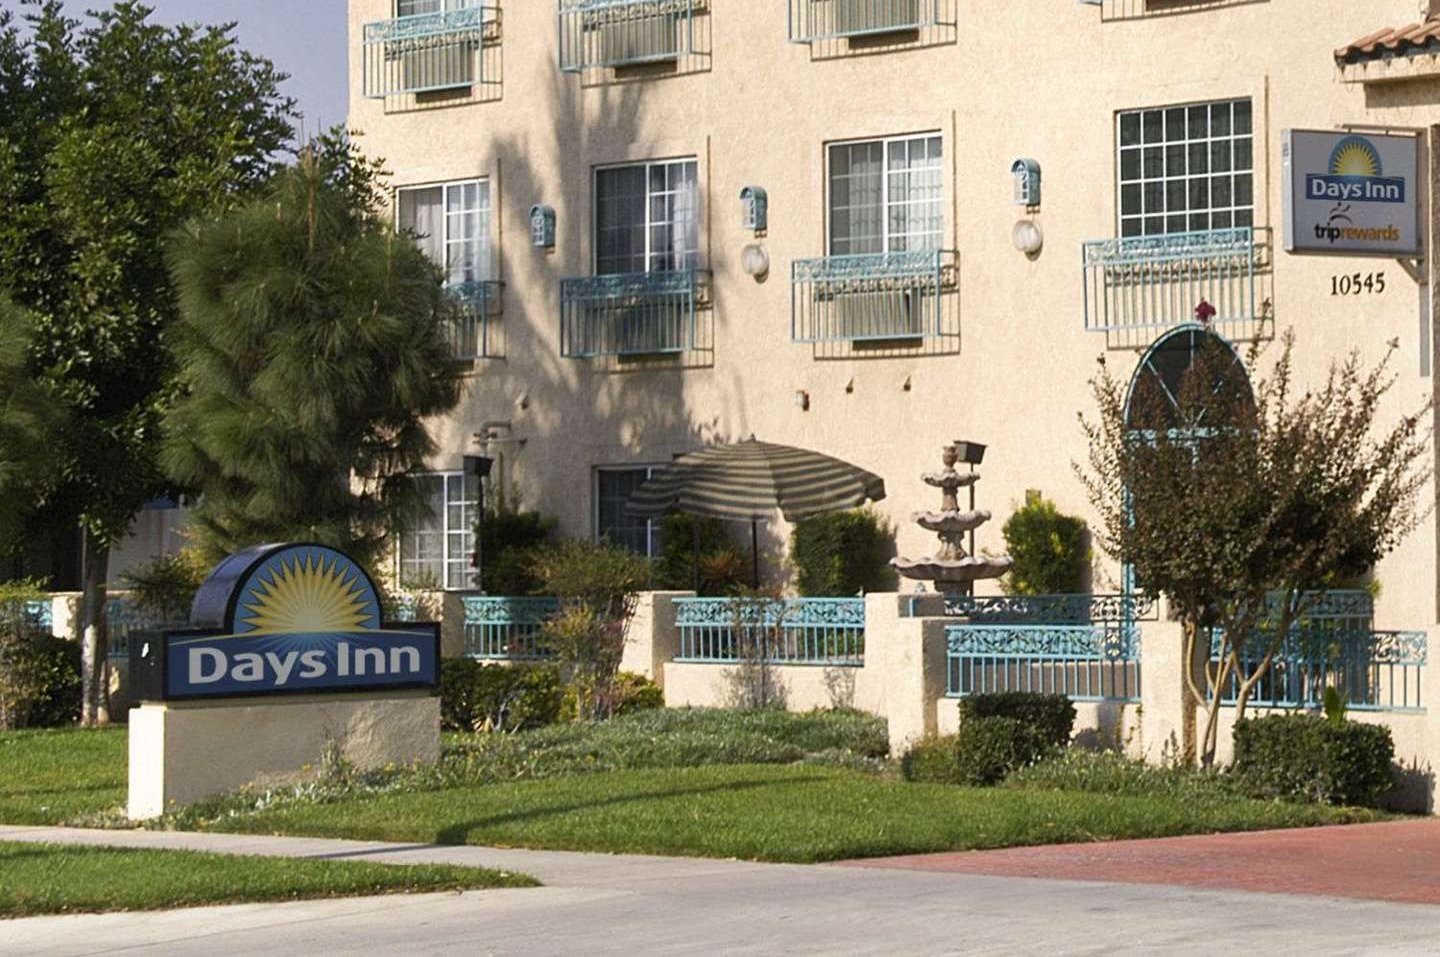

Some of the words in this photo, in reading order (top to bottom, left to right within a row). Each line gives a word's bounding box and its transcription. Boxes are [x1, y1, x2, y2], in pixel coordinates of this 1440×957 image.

[1311, 178, 1362, 199] Days
[1365, 181, 1400, 199] Inn
[1330, 272, 1386, 295] 10545
[188, 645, 328, 686] Days
[336, 641, 421, 677] Inn
